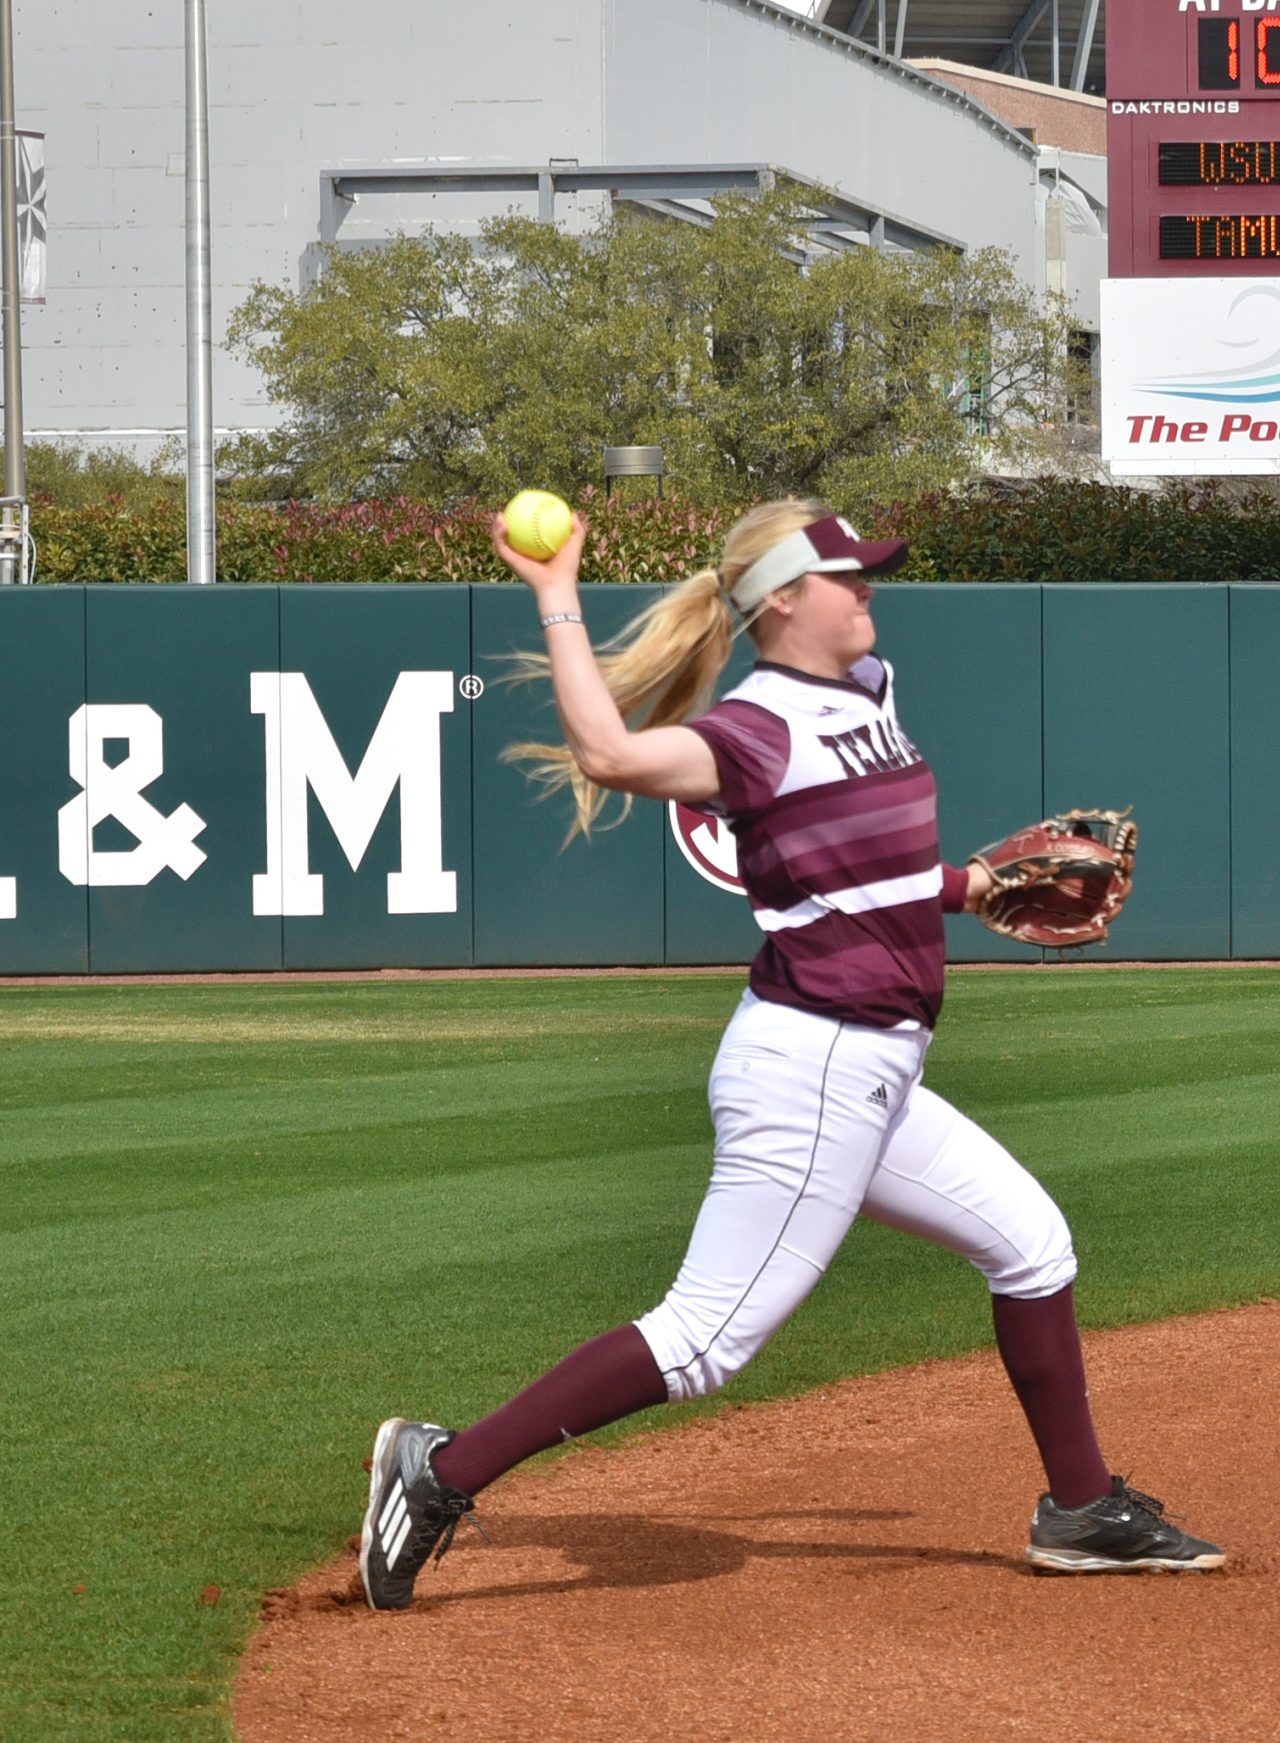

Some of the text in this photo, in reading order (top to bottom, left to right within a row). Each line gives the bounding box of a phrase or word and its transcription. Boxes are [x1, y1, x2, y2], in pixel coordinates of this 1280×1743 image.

[1111, 101, 1240, 115] DAKTRONICS
[1200, 142, 1276, 184] WSU
[1126, 414, 1208, 443] The
[57, 703, 208, 887] &
